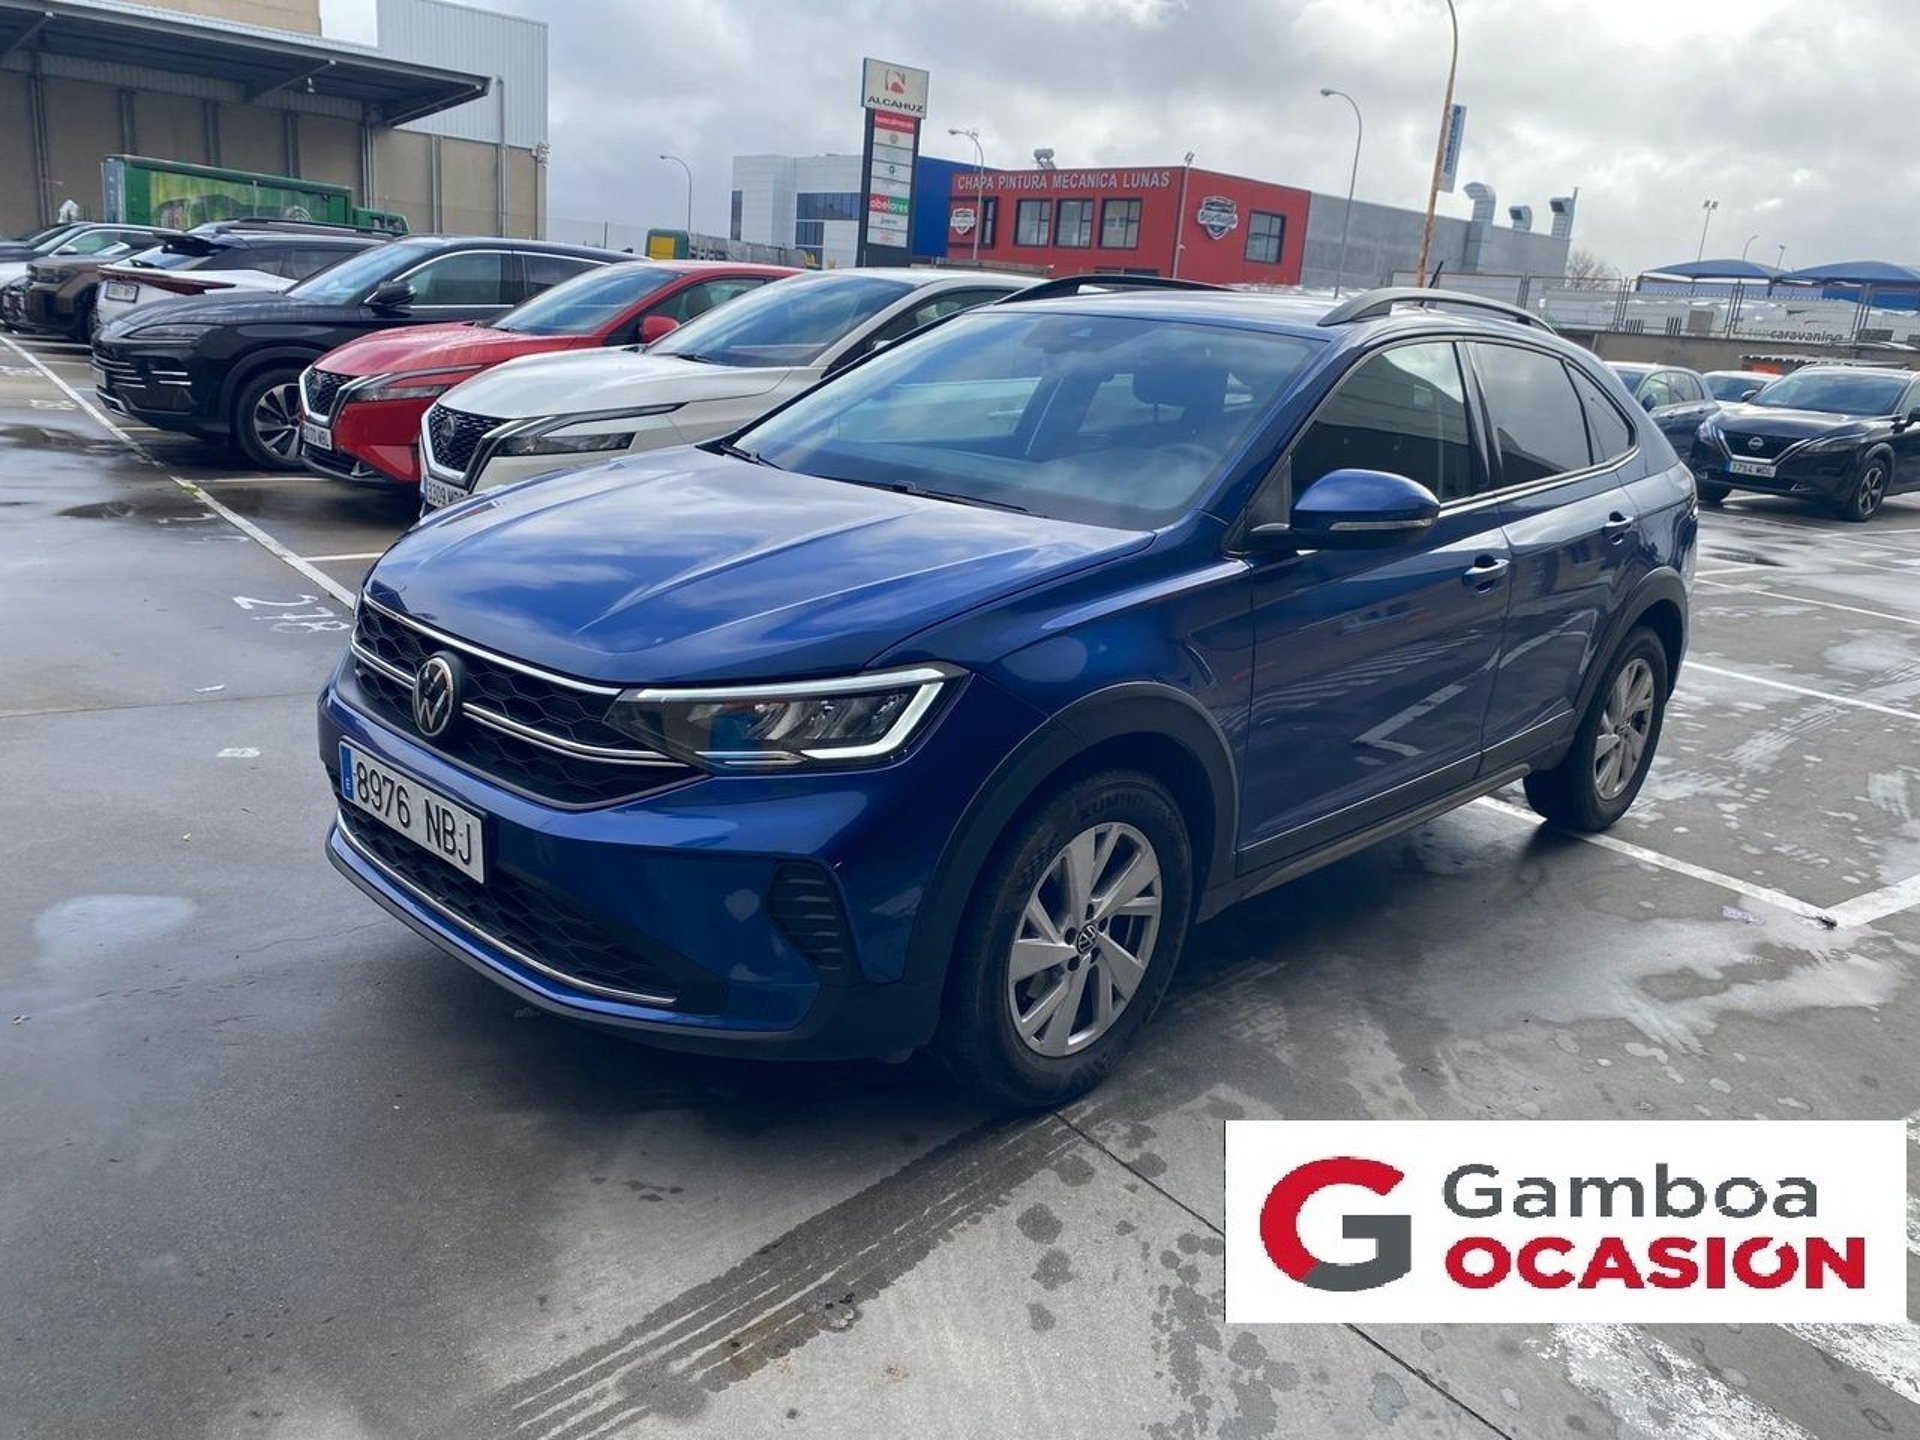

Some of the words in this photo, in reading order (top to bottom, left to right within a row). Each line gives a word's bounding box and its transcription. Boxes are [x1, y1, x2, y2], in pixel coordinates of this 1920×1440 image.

[866, 95, 924, 113] ALCAHUZ
[957, 175, 994, 190] CHAPA
[998, 173, 1048, 190] PINTURA
[1122, 170, 1171, 188] LUNAS
[356, 761, 411, 829] 8976
[424, 798, 472, 866] NBJ
